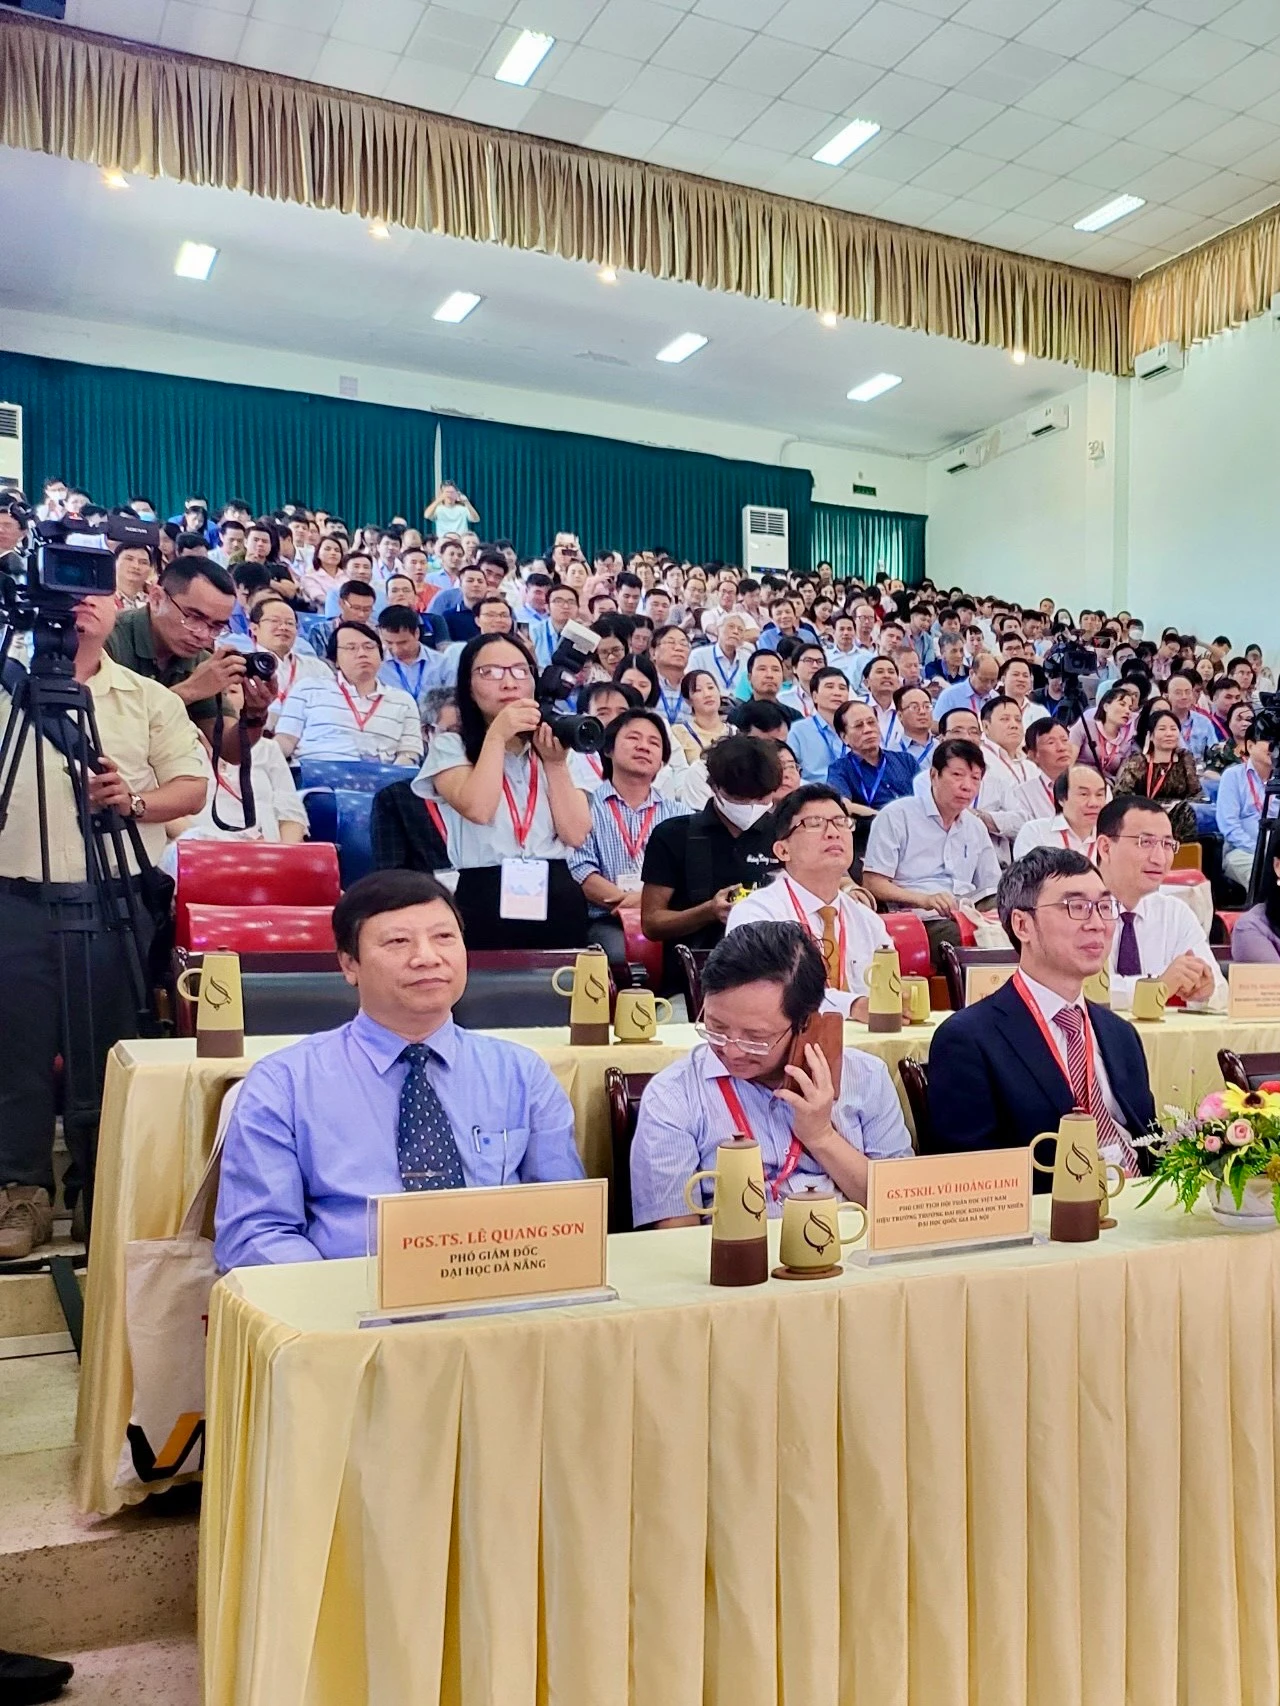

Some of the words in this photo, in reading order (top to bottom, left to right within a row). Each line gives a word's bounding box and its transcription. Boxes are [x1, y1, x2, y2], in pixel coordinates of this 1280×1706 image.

[887, 1187, 935, 1200] GS.TSKH.
[938, 1183, 952, 1195] VŨ
[955, 1179, 992, 1193] HOÀNG
[994, 1177, 1019, 1188] LINH
[402, 1233, 463, 1249] PGS.TS.
[467, 1227, 487, 1245] LÊ
[491, 1225, 548, 1244] QUANG
[551, 1222, 585, 1236] SƠN
[450, 1250, 475, 1264] PHÓ
[478, 1248, 510, 1261] GIÁM
[513, 1245, 538, 1258] ĐỐC
[440, 1265, 462, 1279] ĐẠI
[465, 1264, 491, 1277] HỌC
[494, 1260, 511, 1273] ĐÀ
[514, 1258, 546, 1271] NẴNG
